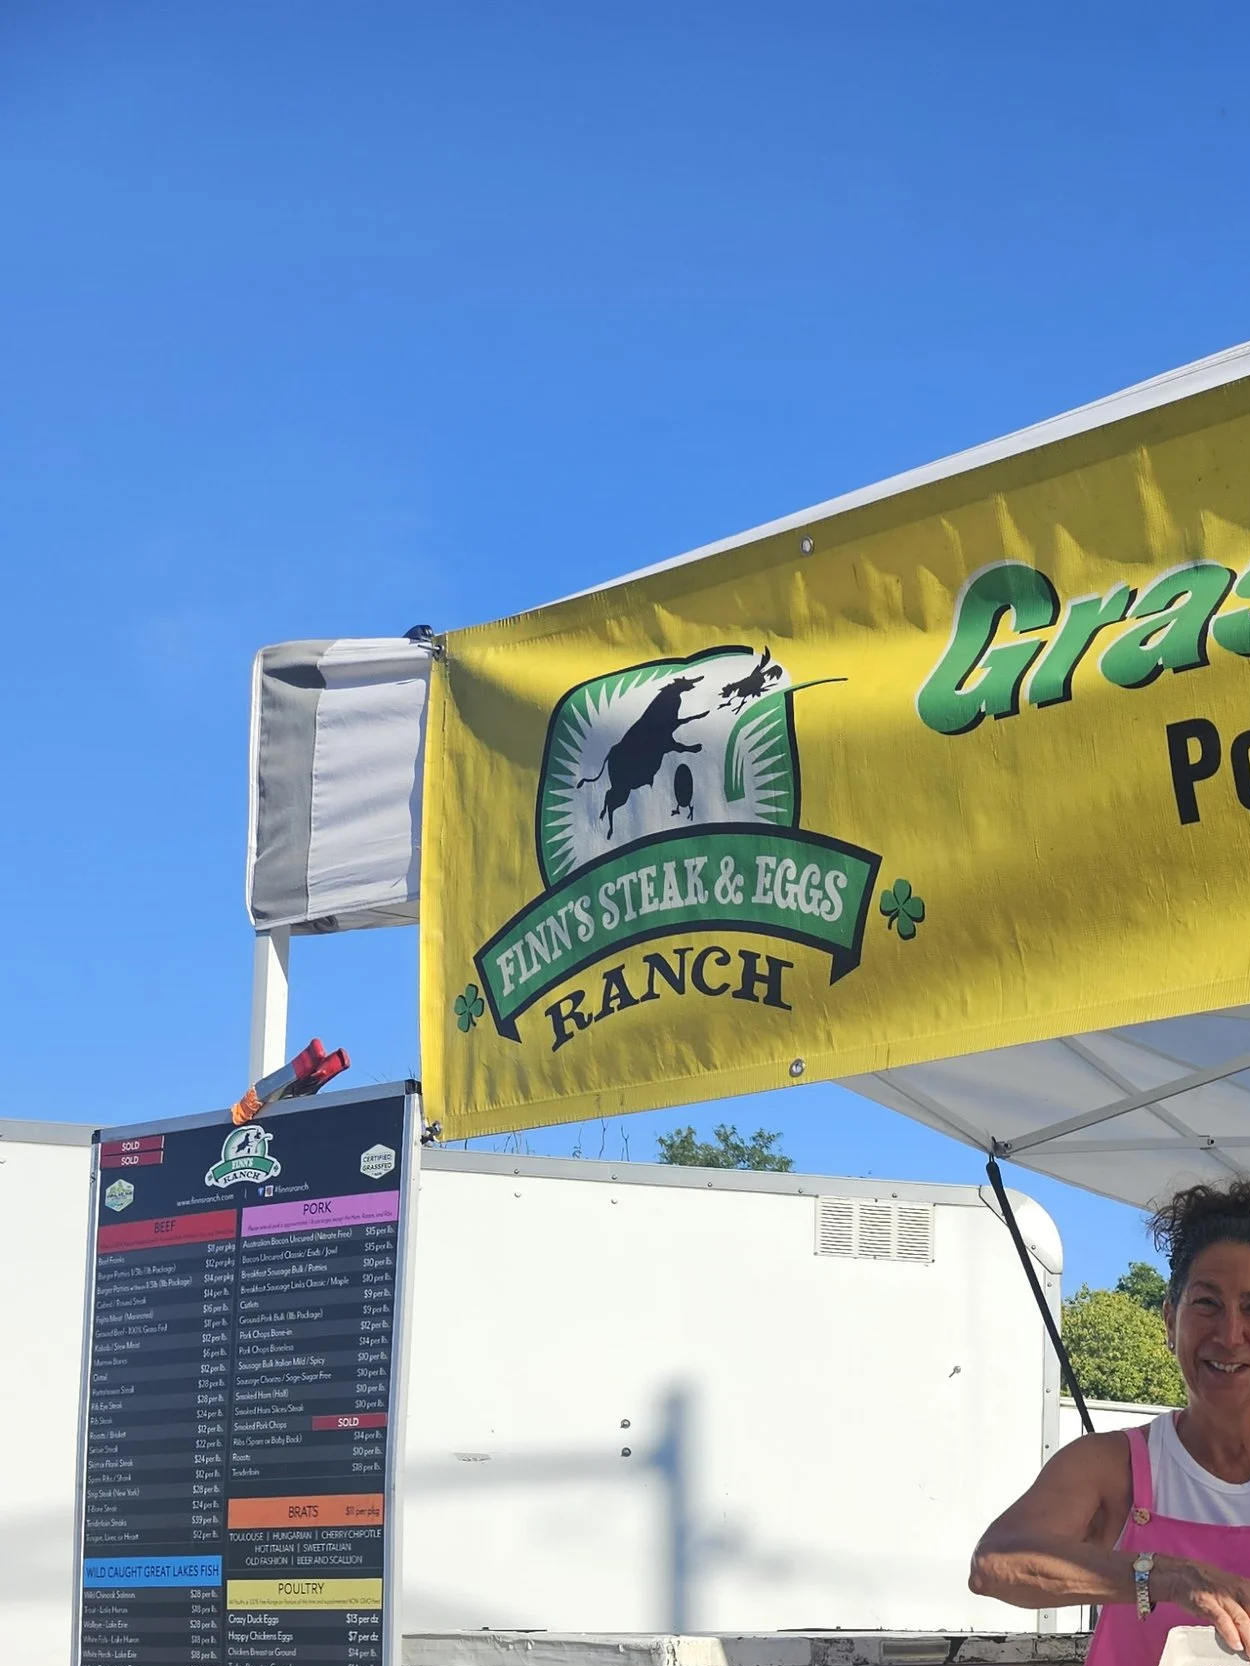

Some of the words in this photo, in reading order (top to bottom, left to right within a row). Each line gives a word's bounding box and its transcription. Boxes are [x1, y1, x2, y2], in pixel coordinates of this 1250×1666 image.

[493, 893, 596, 1000] FINN'S
[596, 854, 709, 933] STEAK
[712, 853, 745, 905] &
[752, 853, 849, 922] EGGS
[546, 942, 794, 1052] RANCH
[122, 1141, 140, 1151] SOLD
[121, 1156, 138, 1165] SOLD
[363, 1154, 392, 1162] CERTIFIED
[362, 1163, 392, 1171] GRASSFED
[223, 1171, 261, 1184] RANCH
[303, 1201, 332, 1215] PORK
[154, 1220, 176, 1233] BEEF
[338, 1418, 359, 1427] SOLD
[288, 1506, 318, 1518] BRATS
[86, 1567, 105, 1578] WILD
[108, 1566, 142, 1578] CAUGHT
[144, 1565, 170, 1577] GREAT
[173, 1565, 198, 1576] LAKES
[201, 1564, 218, 1576] FISH
[278, 1582, 325, 1594] POULTRY
[228, 1614, 246, 1625] Crazy
[247, 1614, 263, 1623] Duck
[263, 1615, 279, 1626] Eggs
